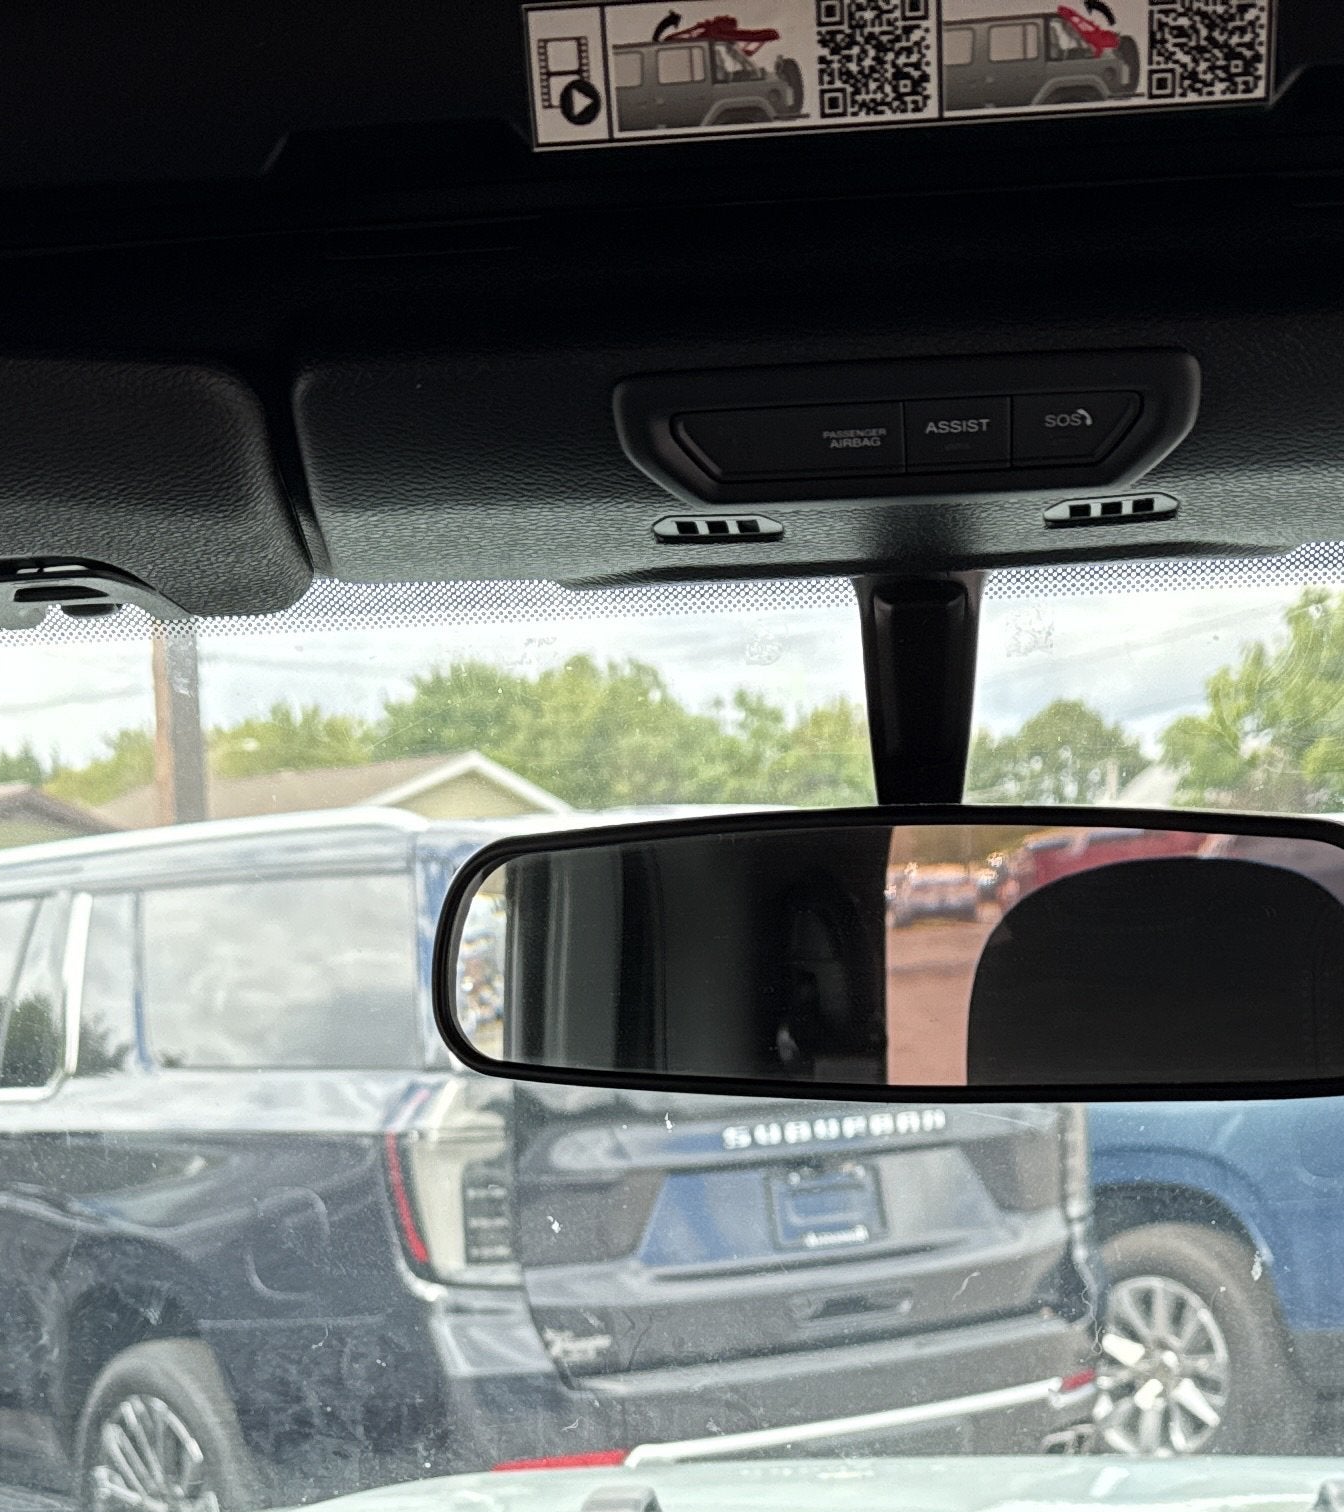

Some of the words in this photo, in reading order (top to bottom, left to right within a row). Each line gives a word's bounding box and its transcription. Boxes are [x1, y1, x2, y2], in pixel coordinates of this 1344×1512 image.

[924, 417, 992, 436] ASSIST
[1043, 413, 1083, 430] SOS
[821, 427, 888, 440] PASSENGER
[829, 435, 882, 450] AIRBAG
